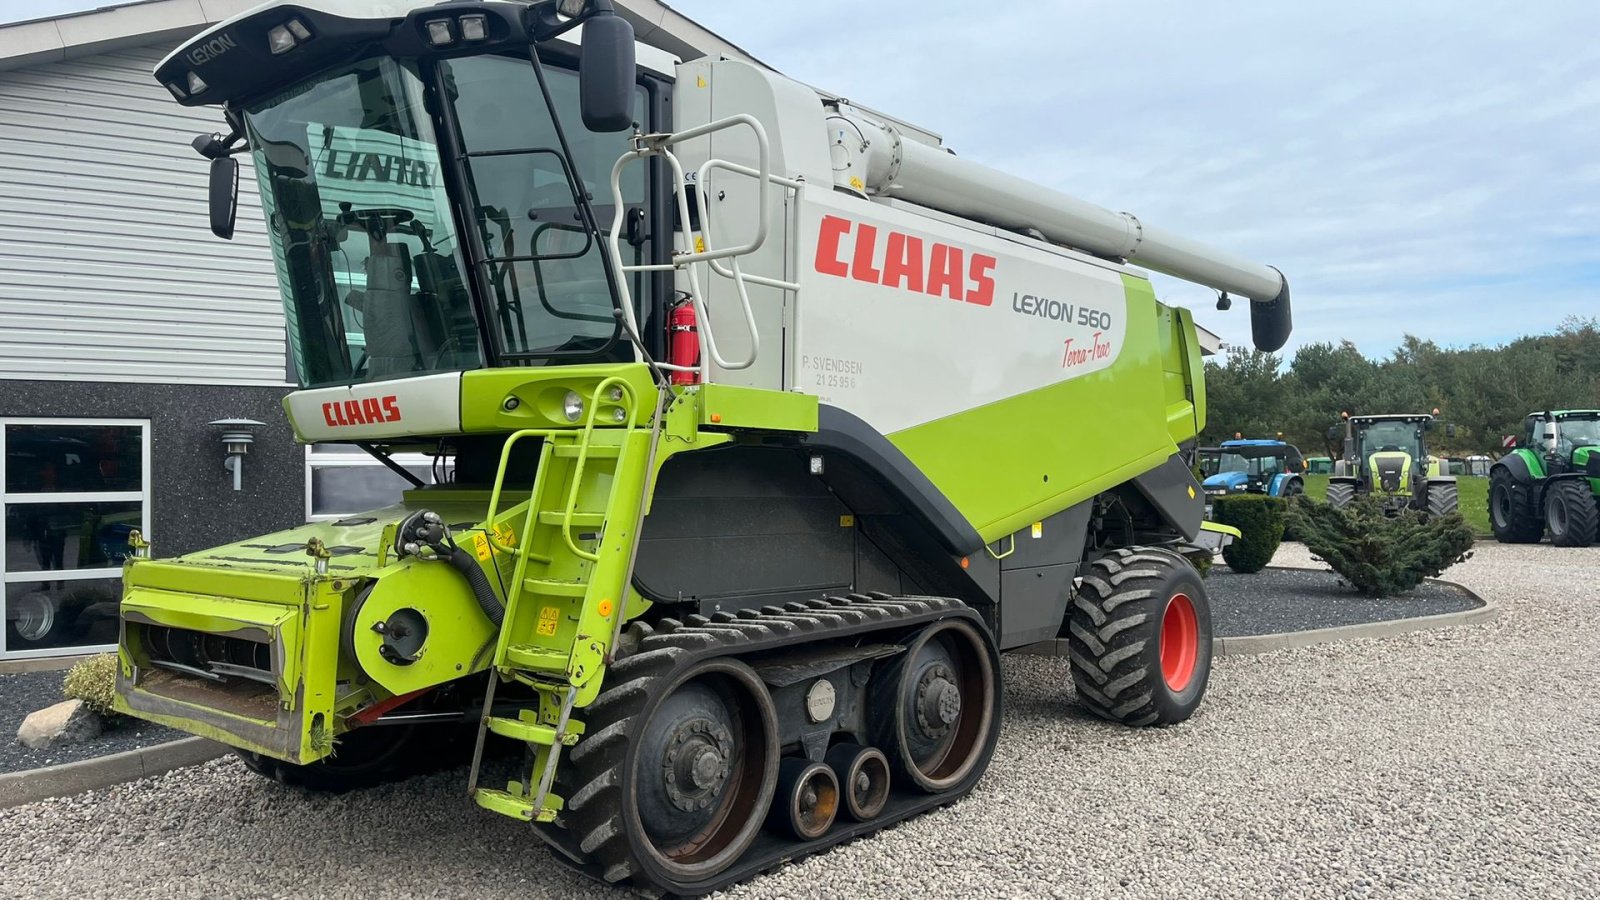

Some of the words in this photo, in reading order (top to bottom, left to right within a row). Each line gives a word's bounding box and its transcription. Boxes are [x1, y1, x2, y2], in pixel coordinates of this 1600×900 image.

[186, 33, 237, 66] LEXION
[815, 215, 997, 307] CLAAS
[1013, 291, 1074, 324] LEXION
[1077, 306, 1111, 331] 560
[802, 355, 811, 369] P.
[813, 356, 863, 375] SVENDSEN
[1062, 332, 1111, 368] Terra-Trac
[322, 395, 401, 427] CLAAS
